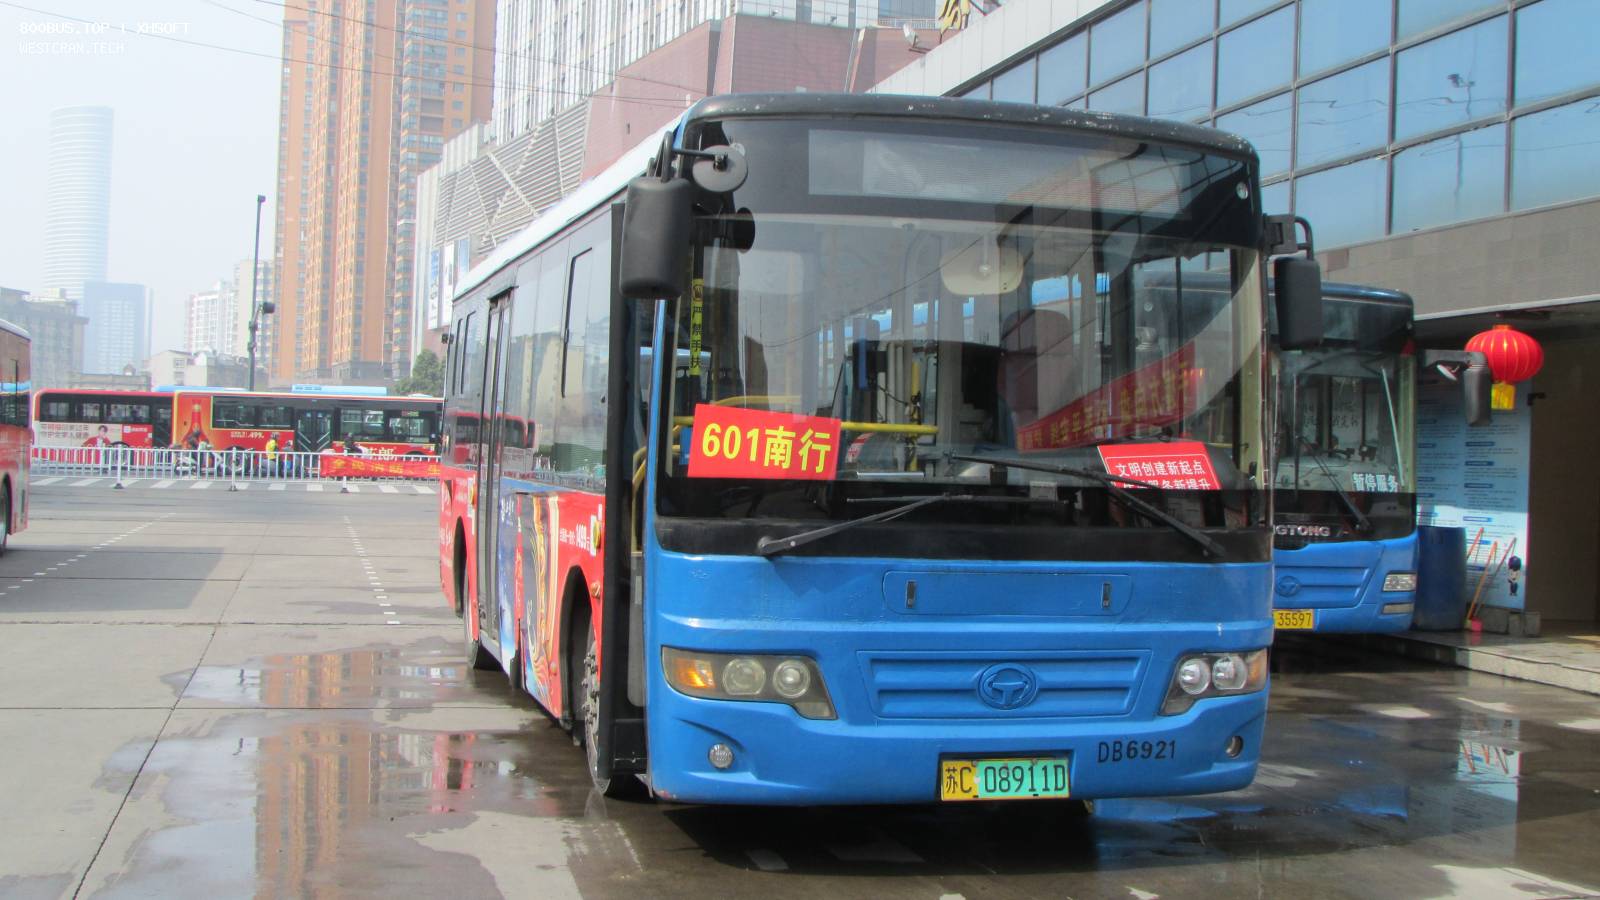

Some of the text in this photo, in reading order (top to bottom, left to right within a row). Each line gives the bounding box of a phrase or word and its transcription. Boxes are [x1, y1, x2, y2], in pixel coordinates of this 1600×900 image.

[702, 423, 831, 473] 601南行
[1115, 460, 1206, 477] 文明创建新起点
[1352, 472, 1399, 492] 暂停服务
[1279, 612, 1312, 626] 35597
[1097, 739, 1176, 763] DB6921
[945, 765, 1066, 794] 苏C 08911D
